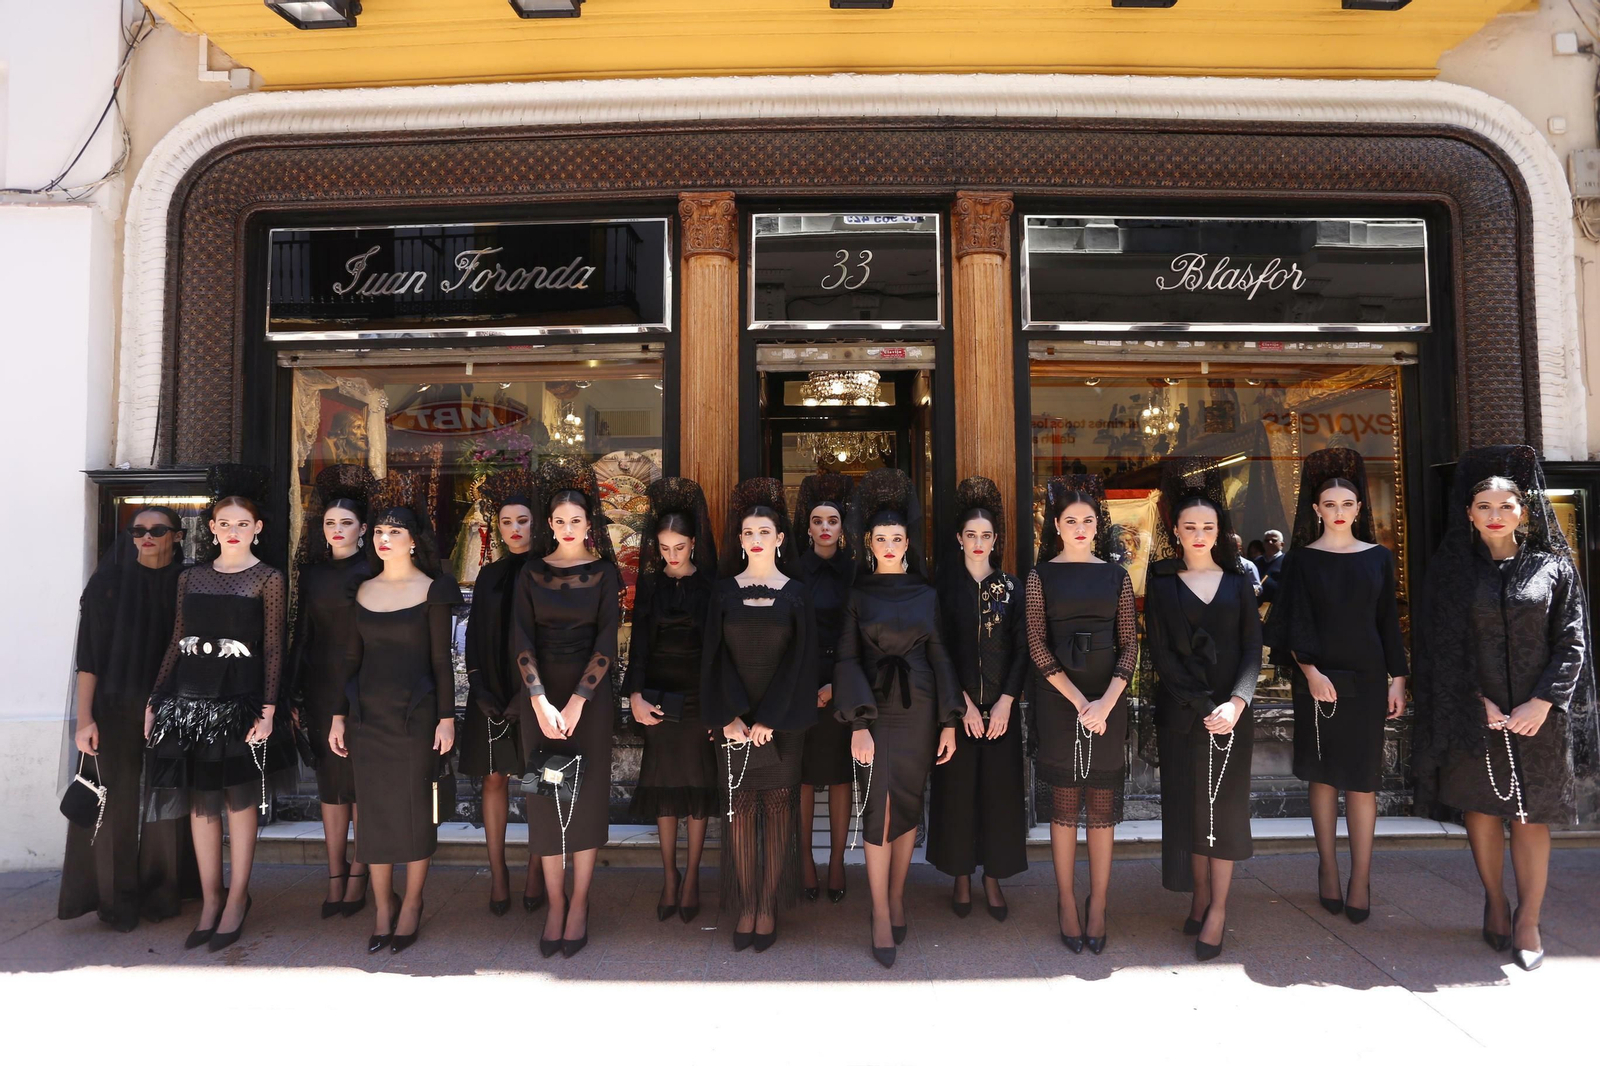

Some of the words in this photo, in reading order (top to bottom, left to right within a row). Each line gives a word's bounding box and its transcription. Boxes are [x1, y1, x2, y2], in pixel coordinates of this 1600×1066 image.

[333, 245, 427, 295] Juan
[440, 247, 597, 293] Foronda
[820, 249, 873, 290] 33
[1155, 252, 1307, 300] Blasfor
